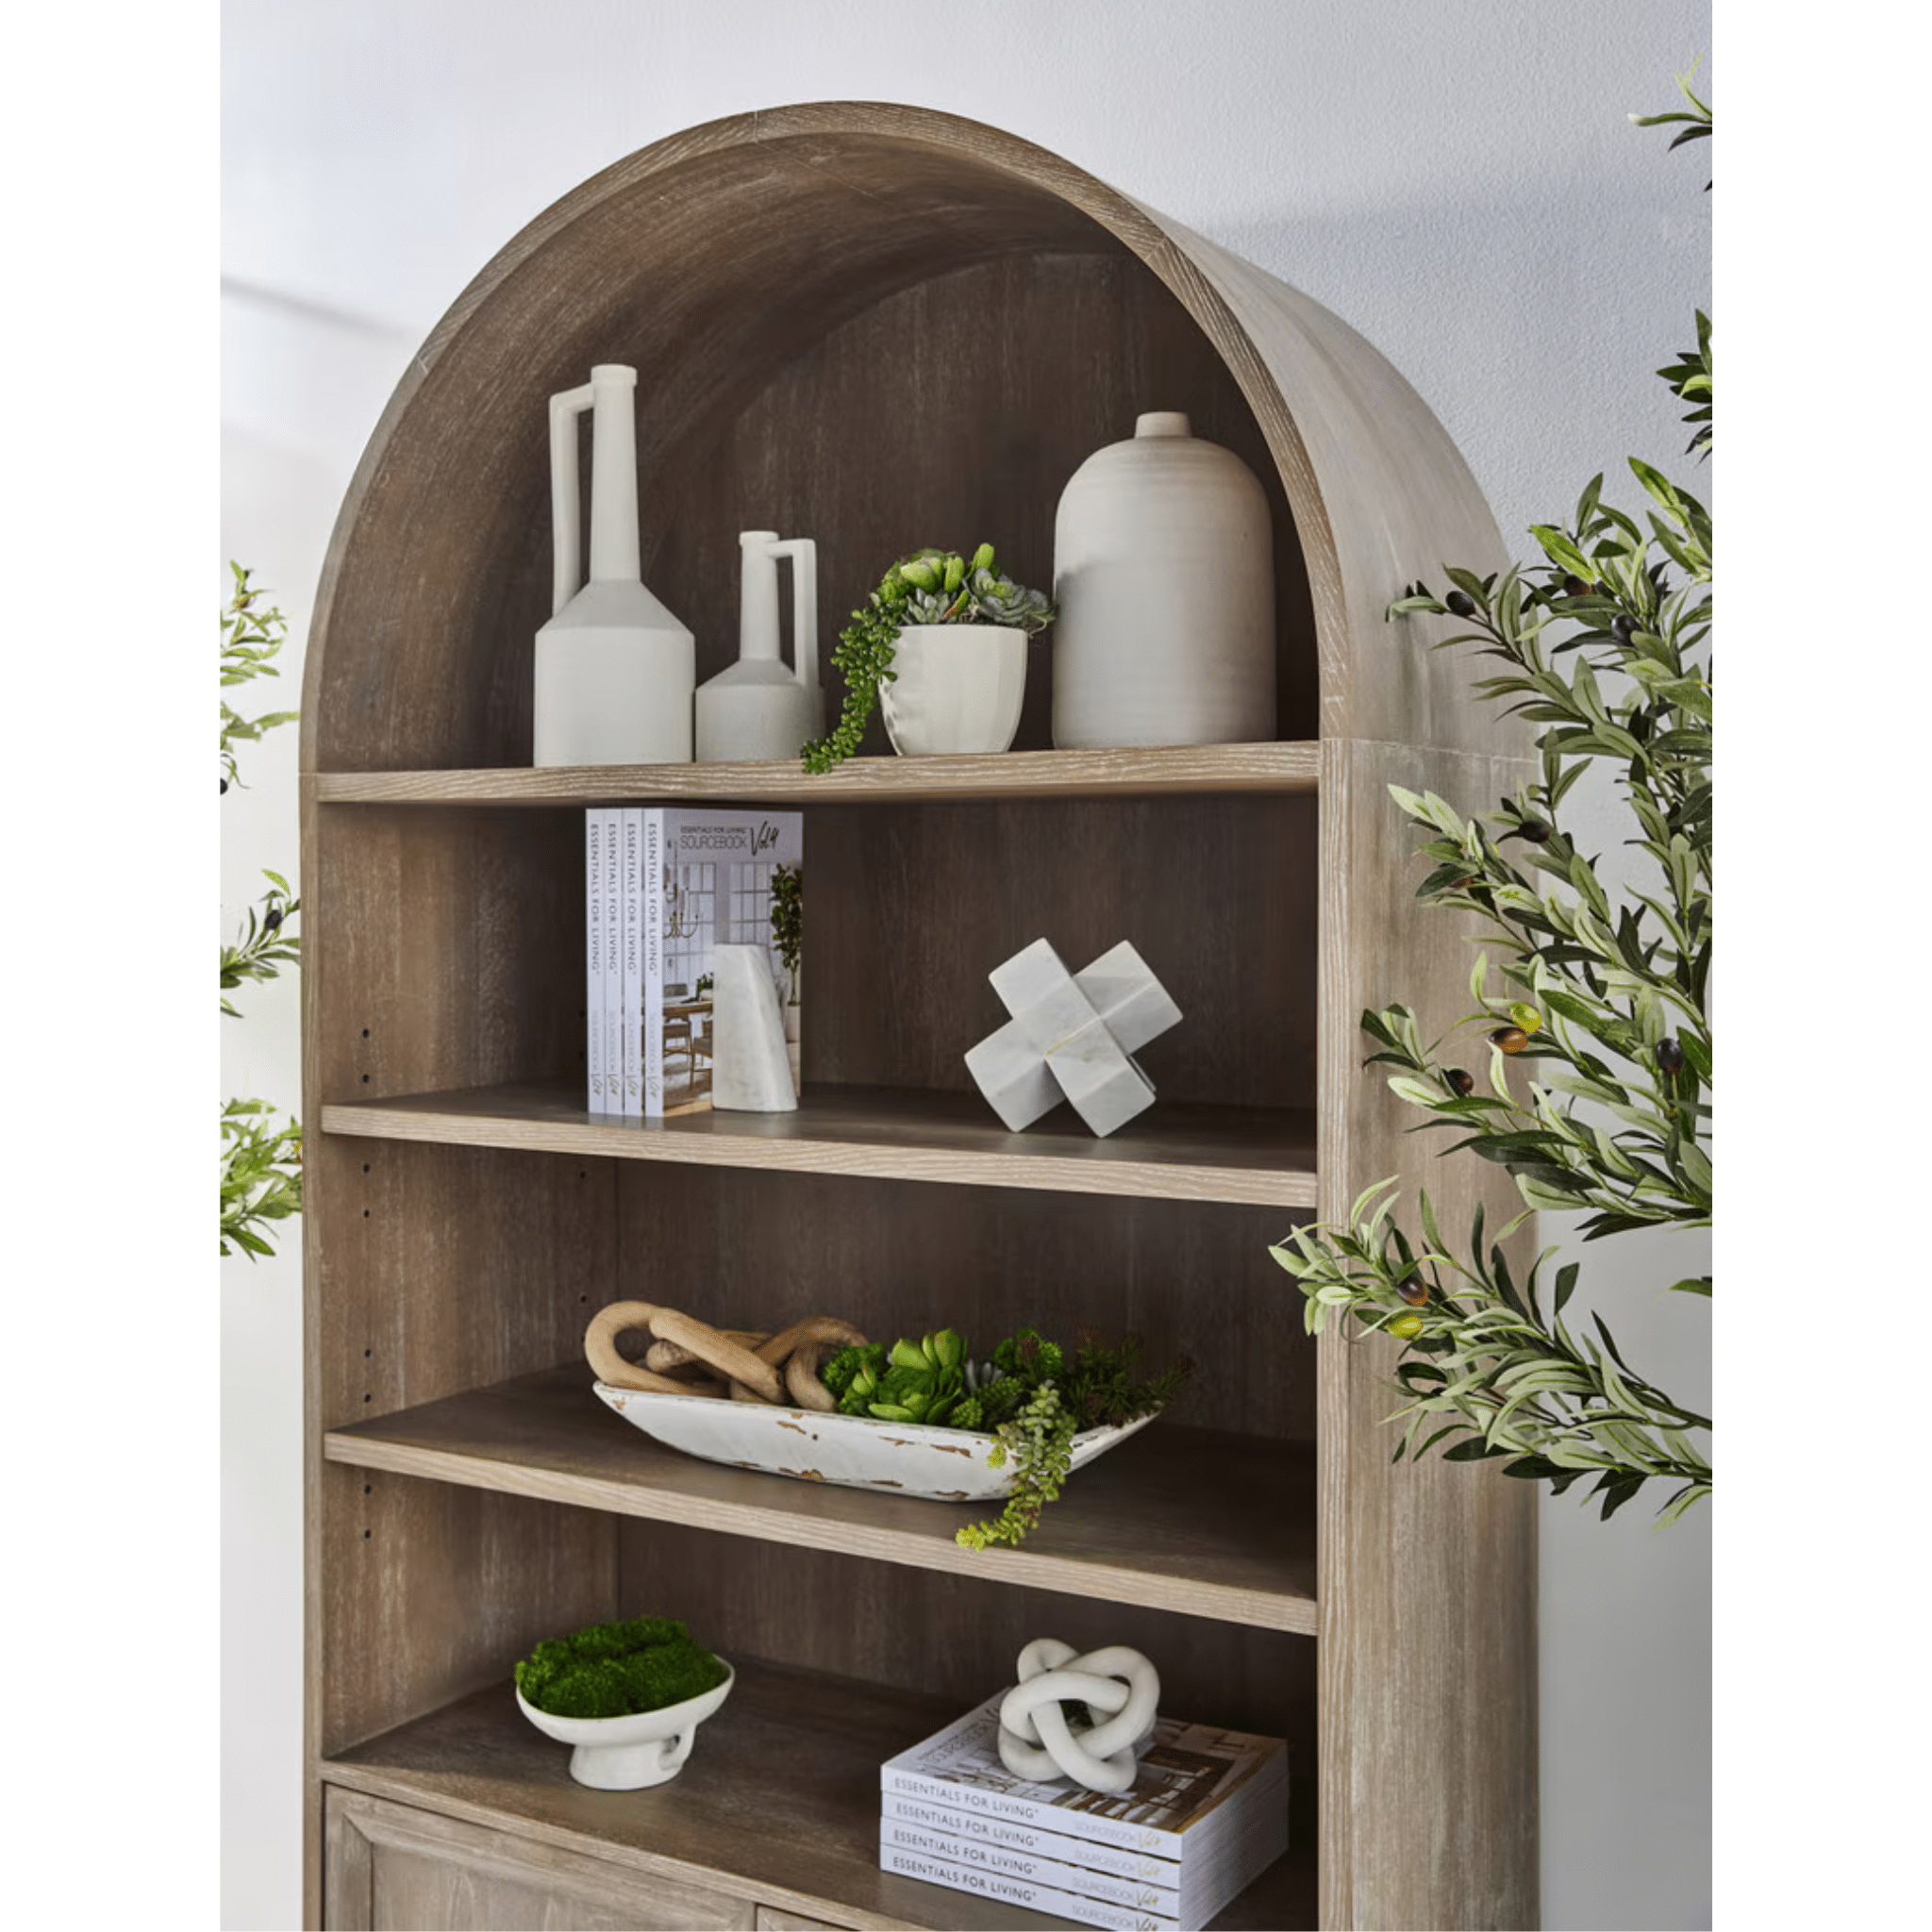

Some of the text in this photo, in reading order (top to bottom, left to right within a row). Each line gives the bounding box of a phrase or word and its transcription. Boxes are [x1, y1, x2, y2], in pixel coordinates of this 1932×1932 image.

[591, 824, 600, 893] ESSENTIALS
[608, 823, 617, 893] ESSENTIALS
[627, 823, 637, 893] ESSENTIALS
[648, 823, 658, 893] ESSENTIALS
[591, 899, 600, 922] FOR
[628, 898, 637, 923] FOR
[649, 898, 658, 923] FOR
[895, 1777, 959, 1802] ESSENTIALS
[965, 1793, 988, 1807] FOR
[896, 1803, 961, 1827] ESSENTIALS
[966, 1820, 989, 1834] FOR
[894, 1829, 959, 1856] ESSENTIALS
[964, 1847, 986, 1861] FOR
[893, 1857, 958, 1882] ESSENTIALS
[962, 1874, 986, 1888] FOR
